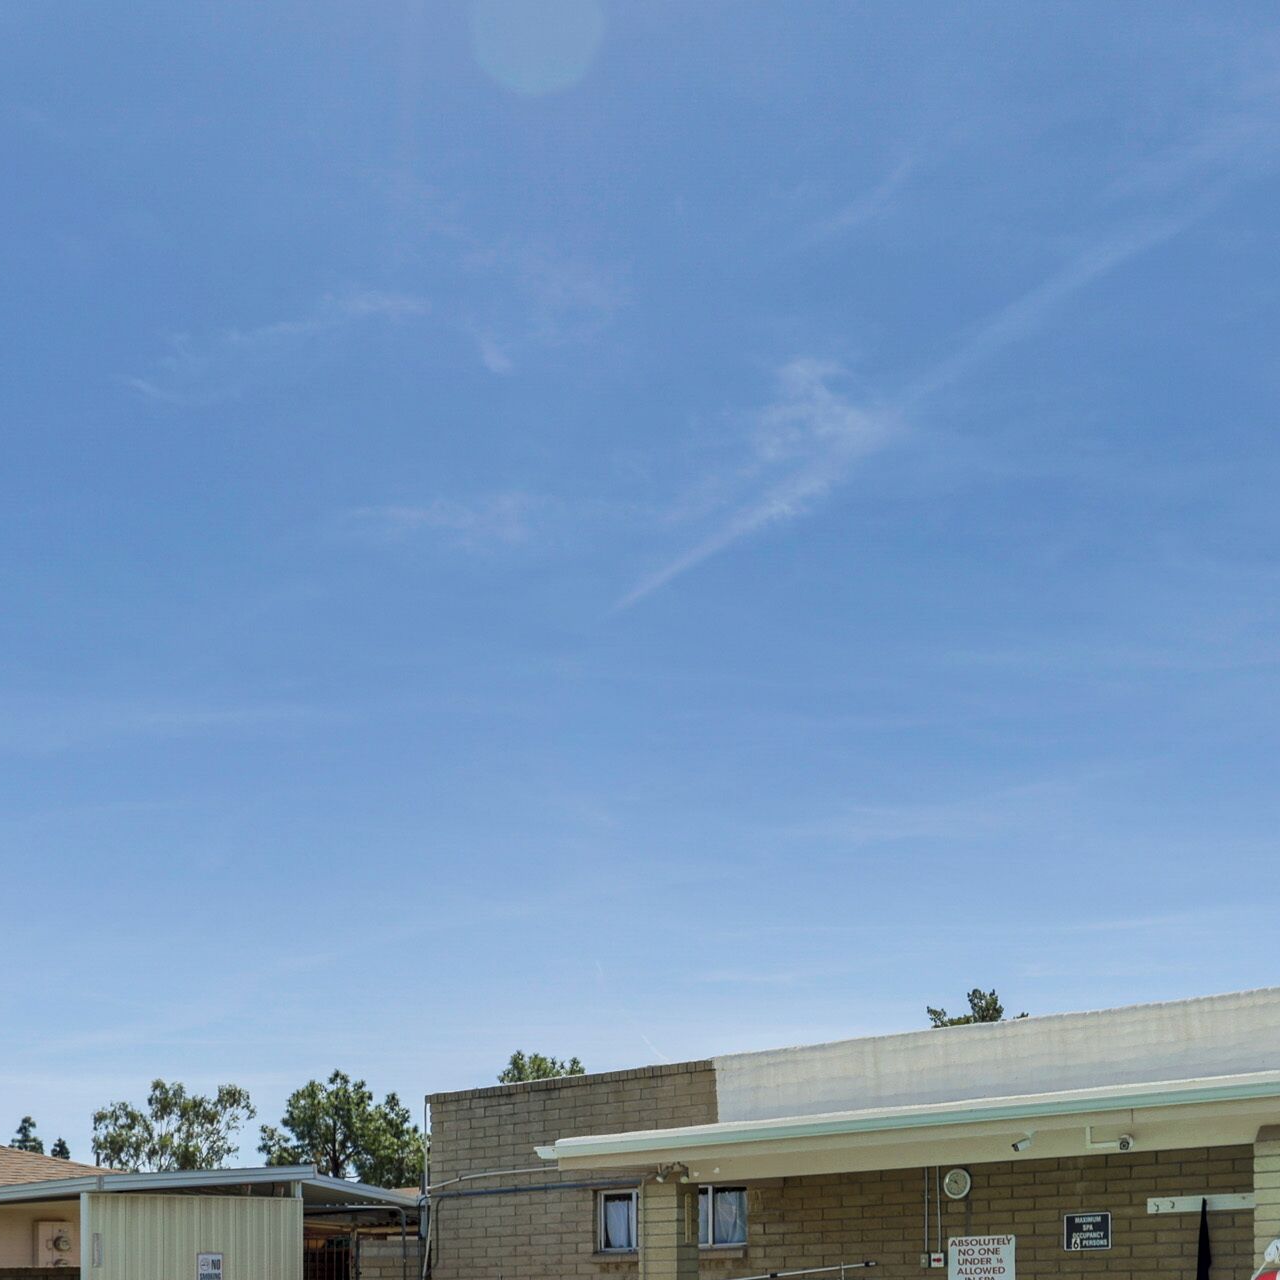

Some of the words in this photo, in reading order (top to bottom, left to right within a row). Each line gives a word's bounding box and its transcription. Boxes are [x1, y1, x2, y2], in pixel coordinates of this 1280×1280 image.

[1074, 1215, 1101, 1223] MAXIMUM
[1072, 1231, 1105, 1240] OCCUPANCY
[950, 1235, 1012, 1247] ABSOLUTELY
[1073, 1239, 1080, 1249] 6
[958, 1248, 975, 1256] NO
[978, 1247, 1001, 1256] ONE
[211, 1259, 221, 1271] NO
[957, 1257, 992, 1266] UNDER
[956, 1266, 1006, 1275] ALLOWED
[199, 1272, 222, 1280] SMOKING
